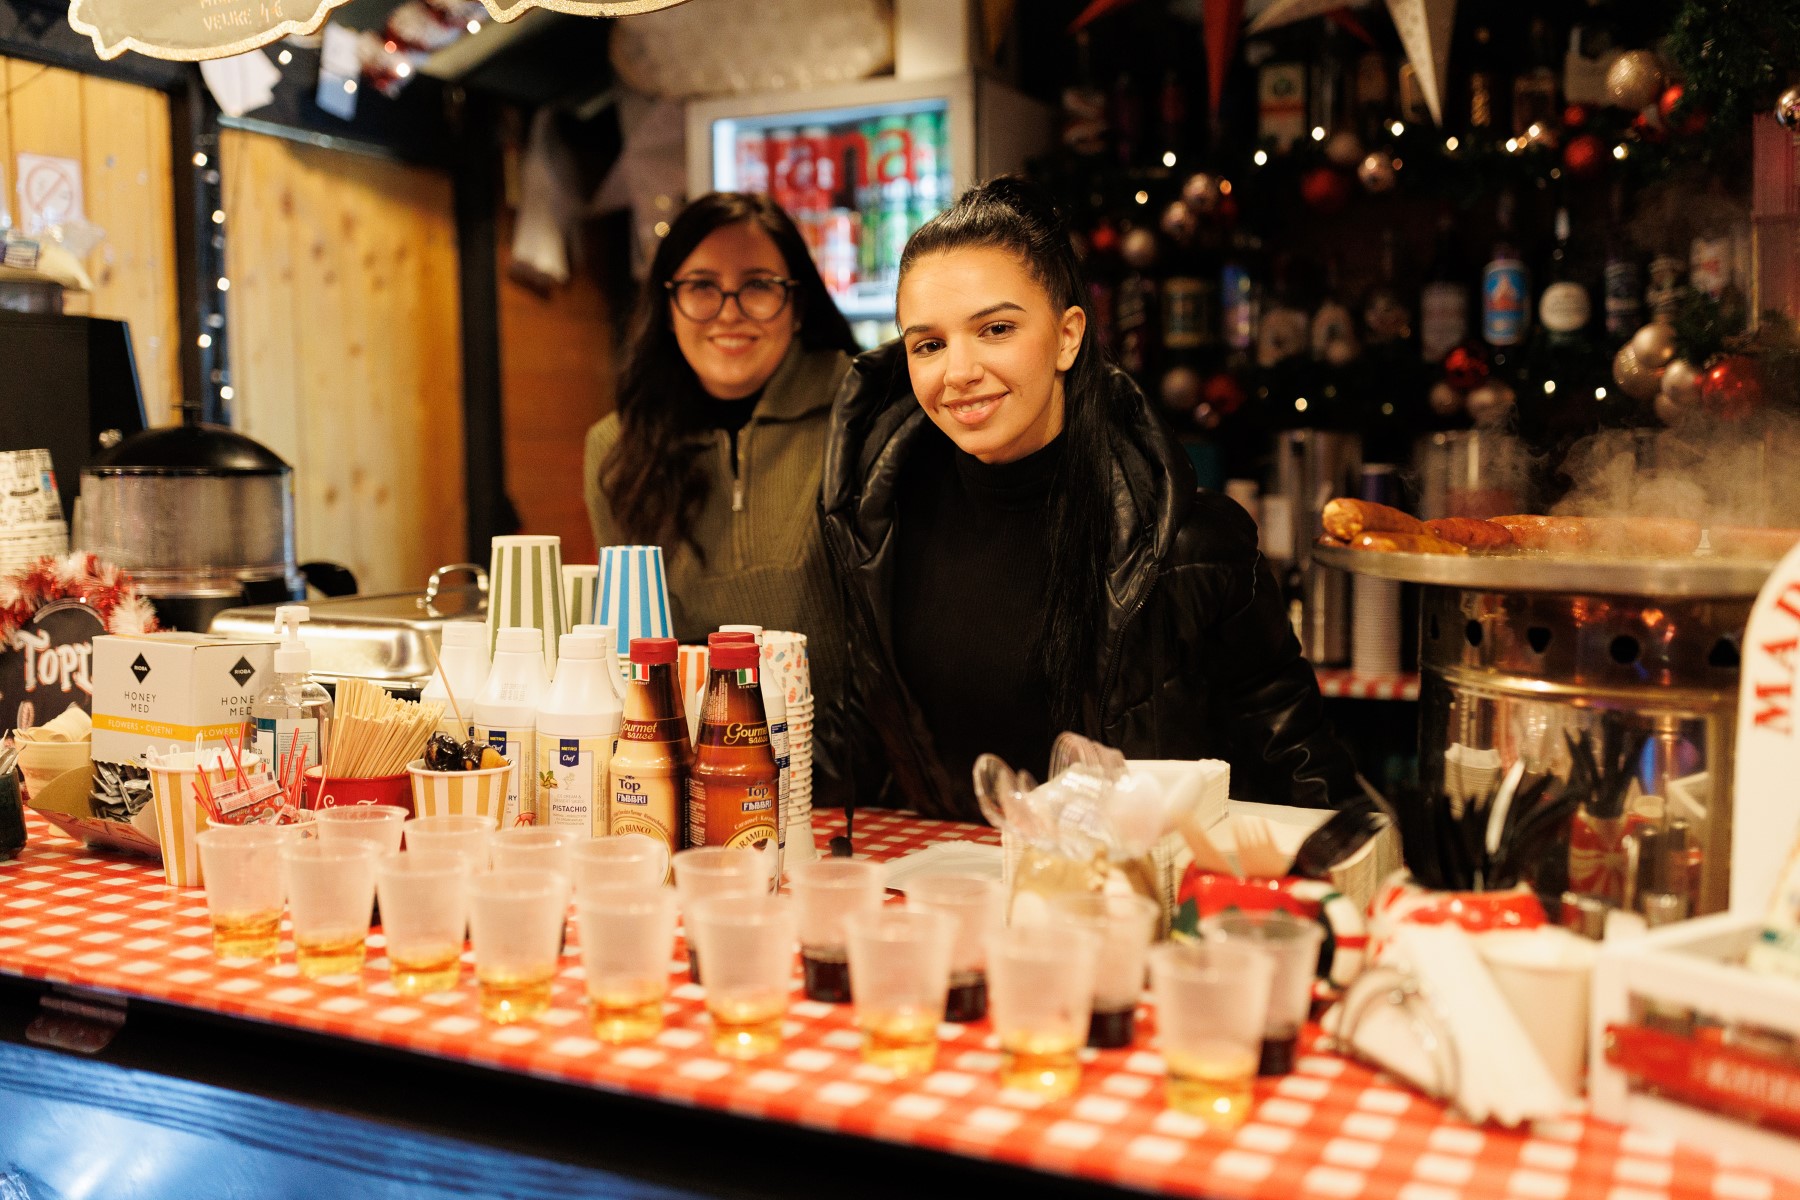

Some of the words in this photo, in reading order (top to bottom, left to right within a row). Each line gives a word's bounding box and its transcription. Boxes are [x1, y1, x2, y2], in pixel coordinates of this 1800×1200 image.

[124, 691, 157, 702] HONEY
[221, 695, 255, 705] HONE
[130, 703, 150, 713] MED
[108, 719, 139, 731] FLOWERS
[145, 724, 173, 734] CVJETNI
[627, 731, 654, 740] sauce
[562, 754, 576, 763] Chef
[618, 778, 642, 793] Top
[747, 786, 769, 798] Top
[617, 793, 647, 804] FABBRI
[552, 804, 587, 813] PISTACHIO
[742, 800, 772, 811] FABBRI
[734, 815, 758, 830] Caramel
[625, 824, 651, 835] BIANCO
